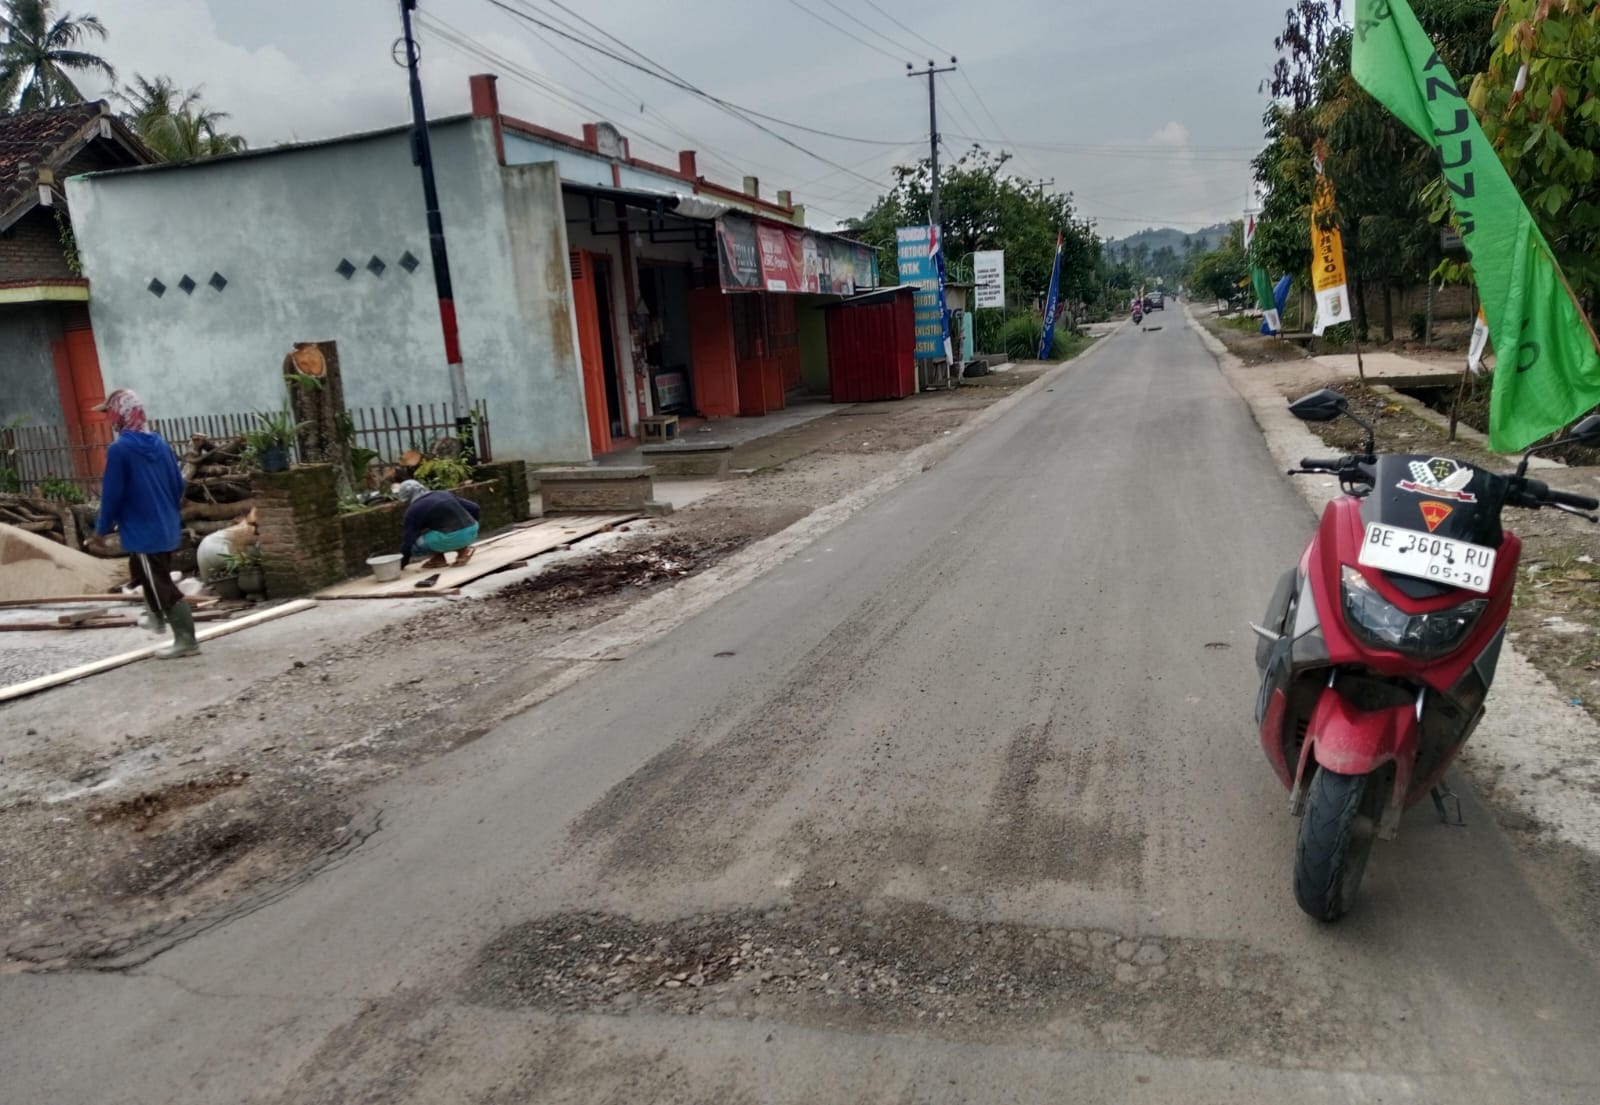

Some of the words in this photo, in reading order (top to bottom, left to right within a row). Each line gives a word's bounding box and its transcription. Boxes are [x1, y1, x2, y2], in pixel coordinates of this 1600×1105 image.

[902, 262, 920, 275] ATK
[1370, 527, 1395, 547] BE
[1406, 534, 1455, 561] 3605
[1465, 547, 1490, 568] RU
